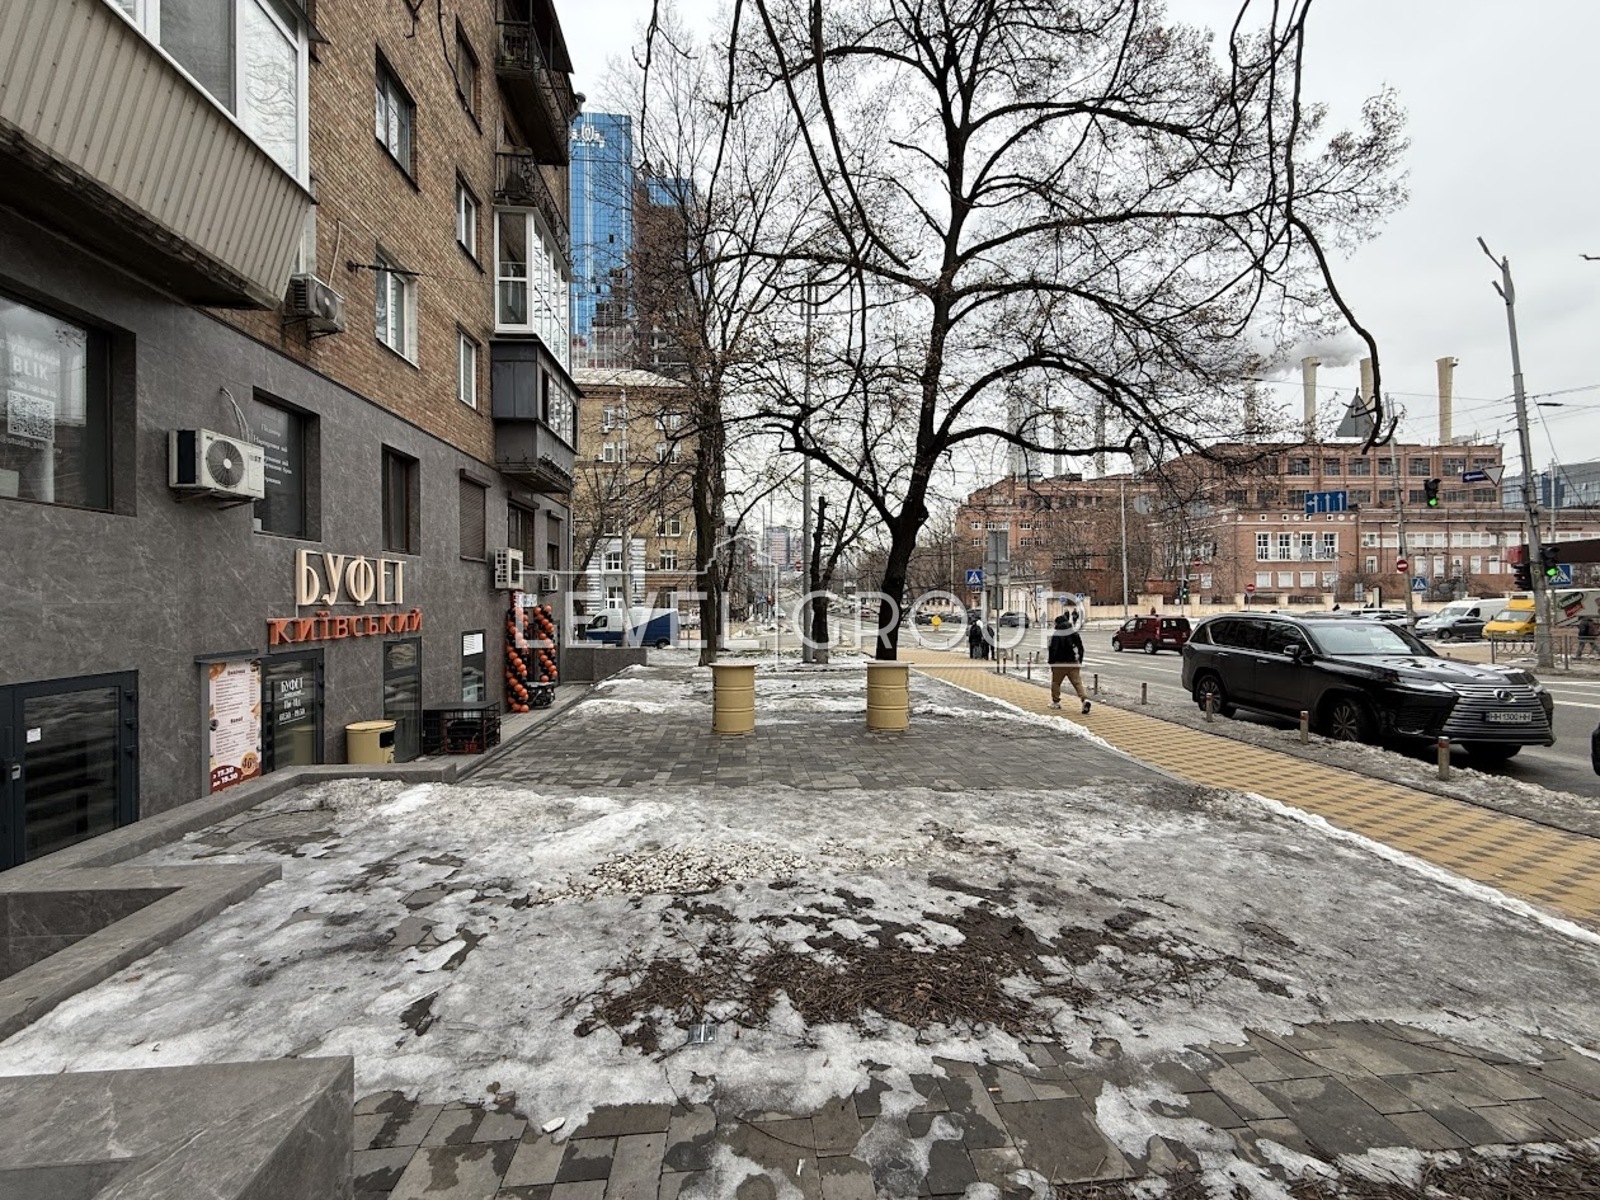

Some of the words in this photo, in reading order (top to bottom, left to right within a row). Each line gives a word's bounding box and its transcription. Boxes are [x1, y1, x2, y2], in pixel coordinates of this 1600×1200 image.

[13, 355, 49, 381] BLIK
[296, 549, 407, 606] БУФЕТ
[267, 607, 424, 645] КИЇВСЬКИЙ
[281, 676, 305, 693] БУФЕТ
